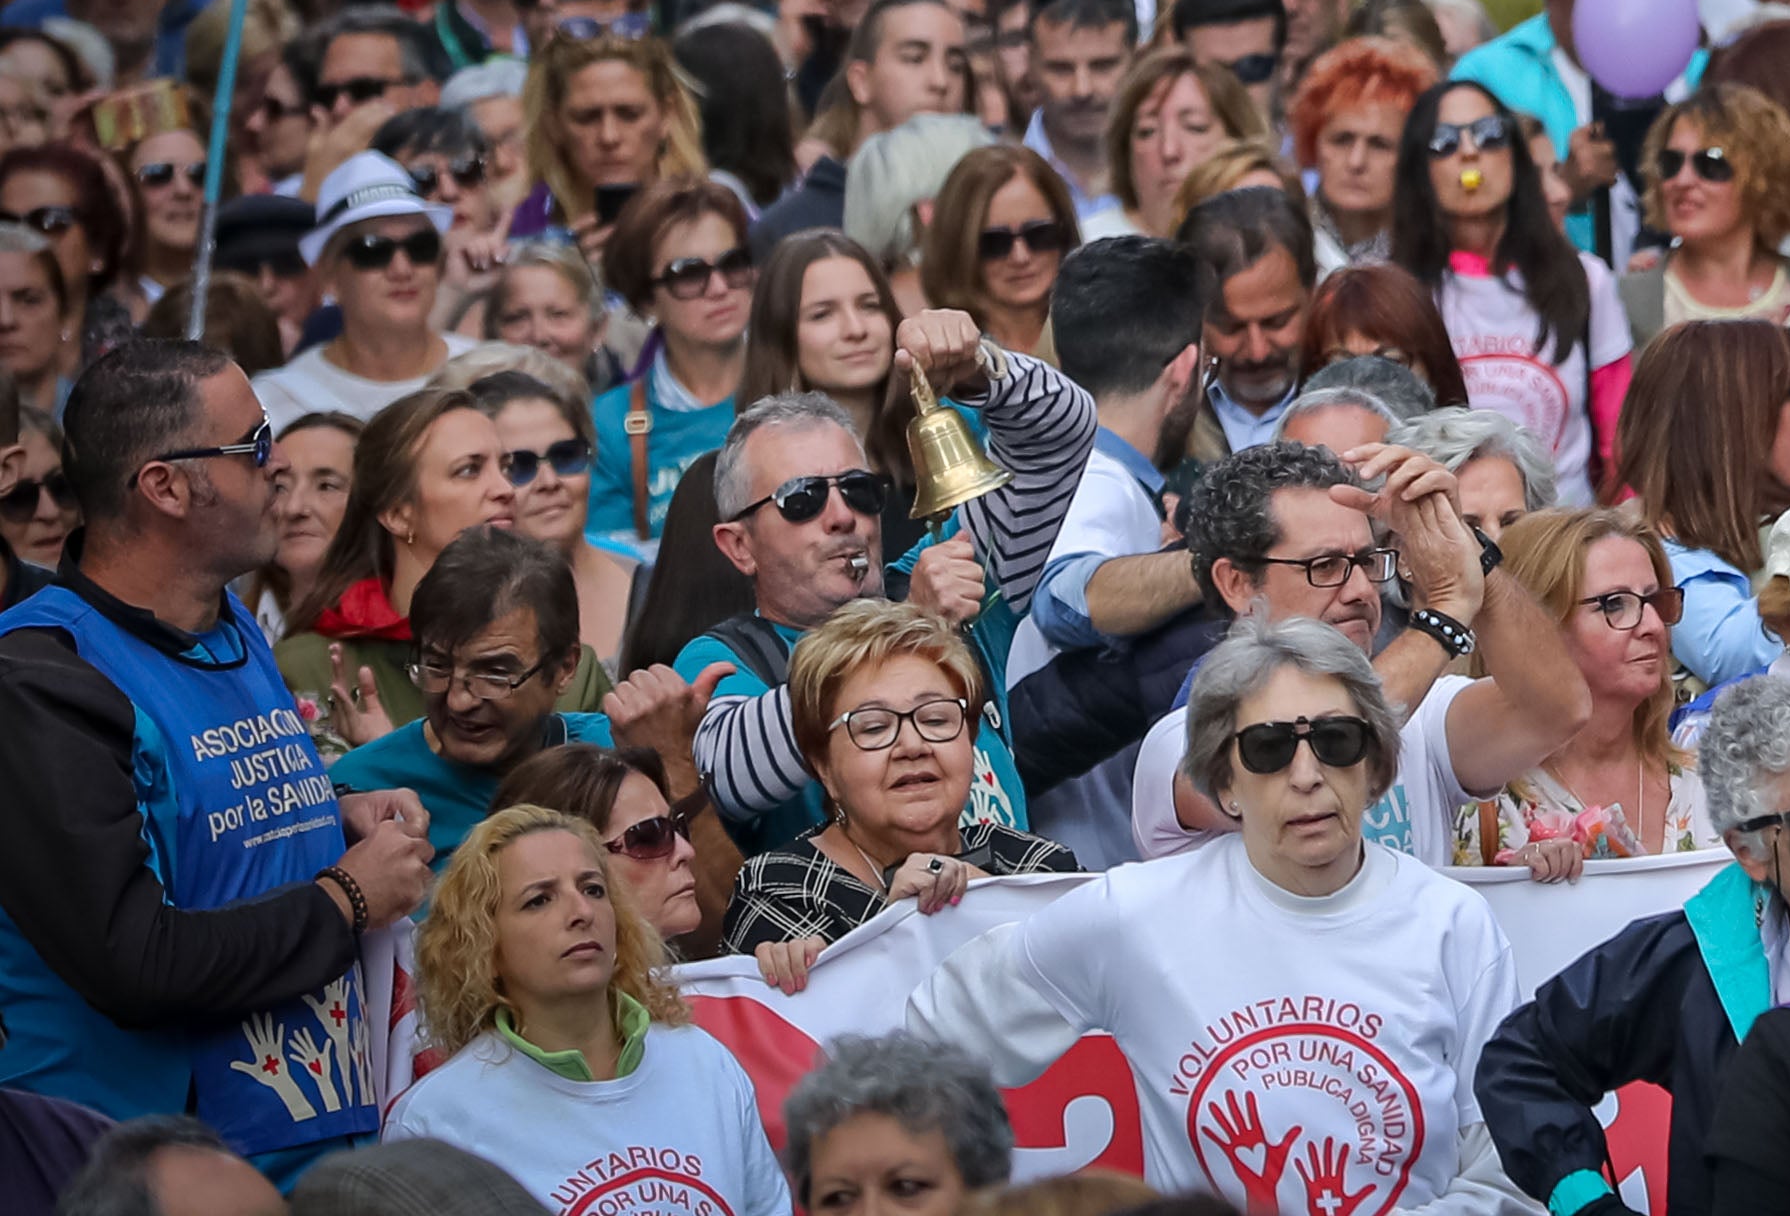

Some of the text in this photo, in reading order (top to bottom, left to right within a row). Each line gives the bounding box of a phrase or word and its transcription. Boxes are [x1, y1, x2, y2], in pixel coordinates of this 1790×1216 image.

[207, 804, 245, 843] por
[244, 794, 269, 823] la
[1168, 995, 1384, 1096] VOLUNTARIOS
[1230, 1039, 1406, 1177] POR UNA SANIDAD
[1260, 1066, 1377, 1166] PÚBLICA DIGNA
[549, 1145, 702, 1206] UNTARIOS
[637, 1182, 691, 1211] UNA
